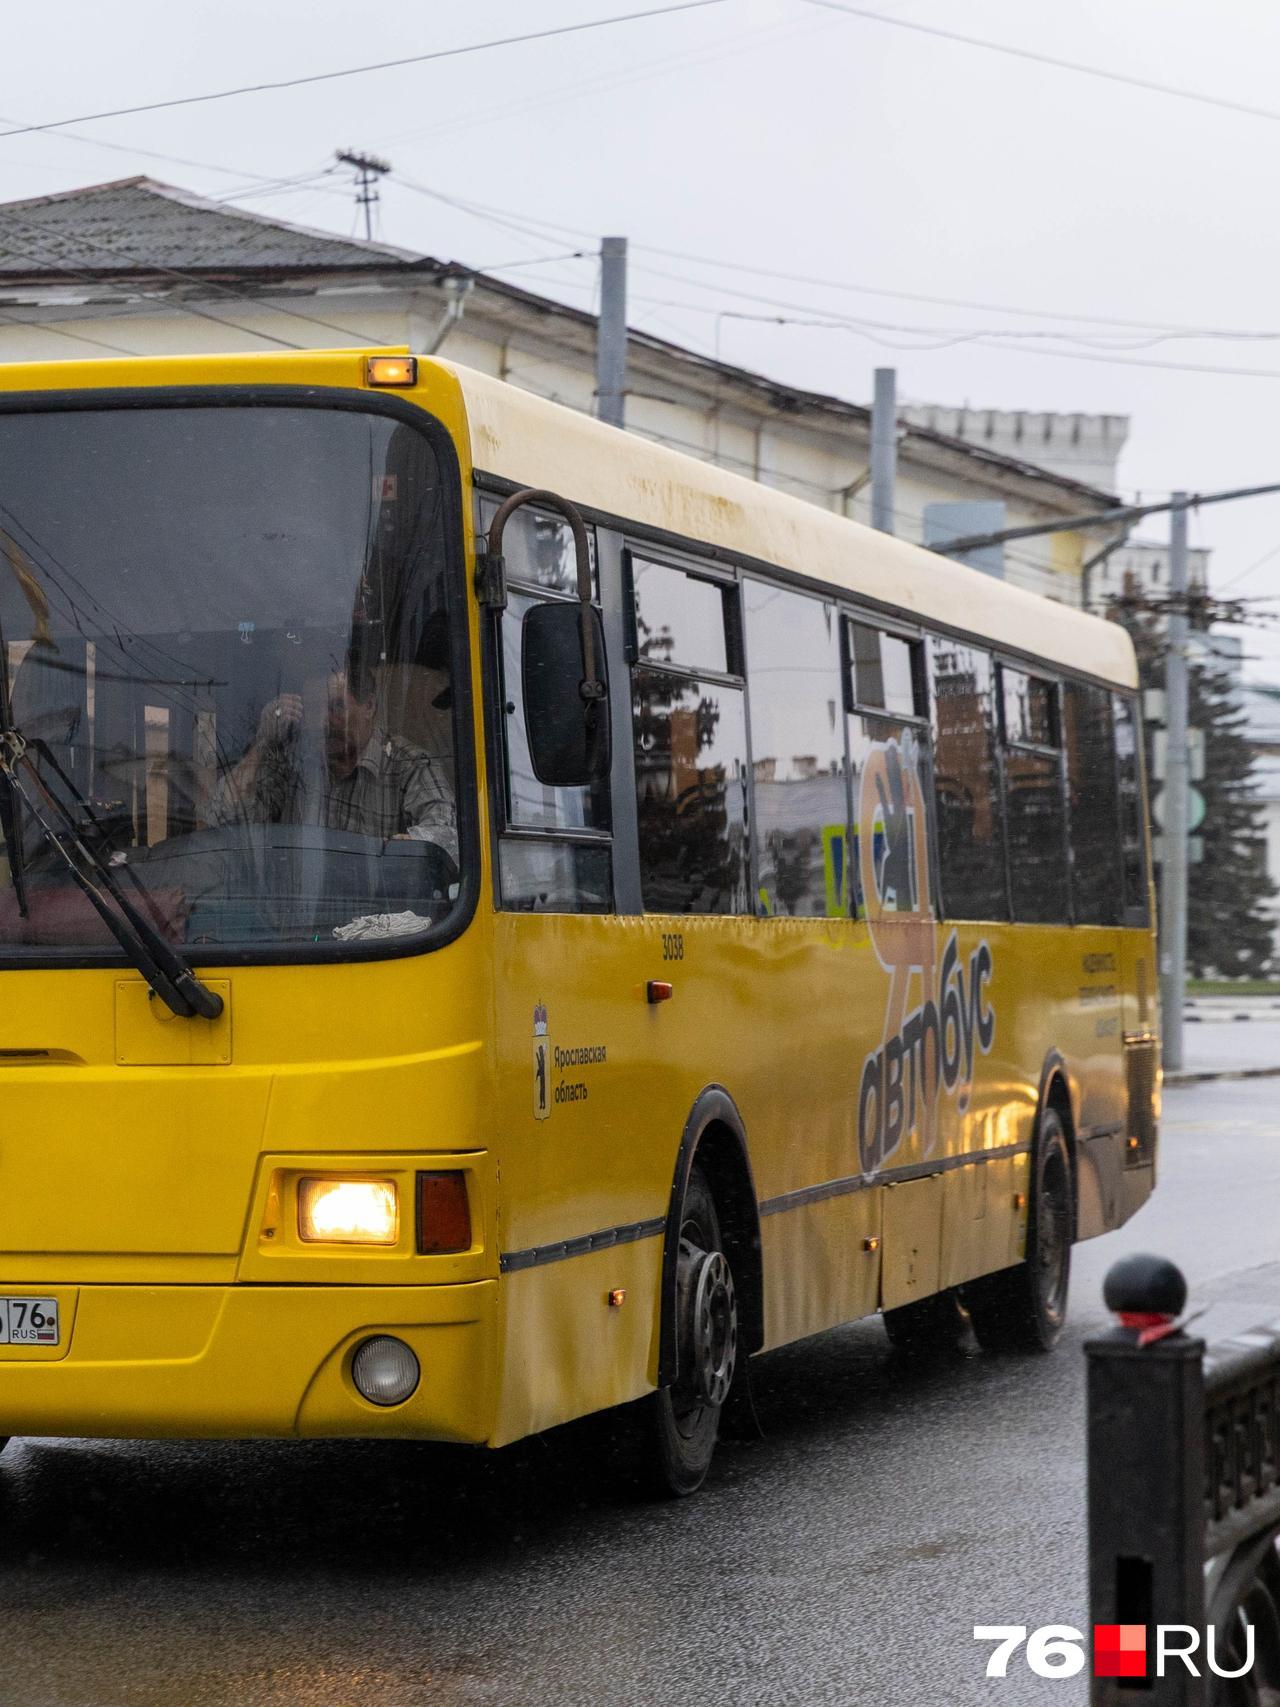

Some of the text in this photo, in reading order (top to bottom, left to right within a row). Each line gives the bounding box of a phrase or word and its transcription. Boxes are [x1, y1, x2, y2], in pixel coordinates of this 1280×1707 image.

[662, 934, 684, 961] 3038
[554, 1046, 607, 1072] Ярославская
[858, 928, 995, 1182] автобус
[555, 1080, 588, 1104] область
[12, 1303, 45, 1329] 76
[12, 1330, 37, 1339] RUS
